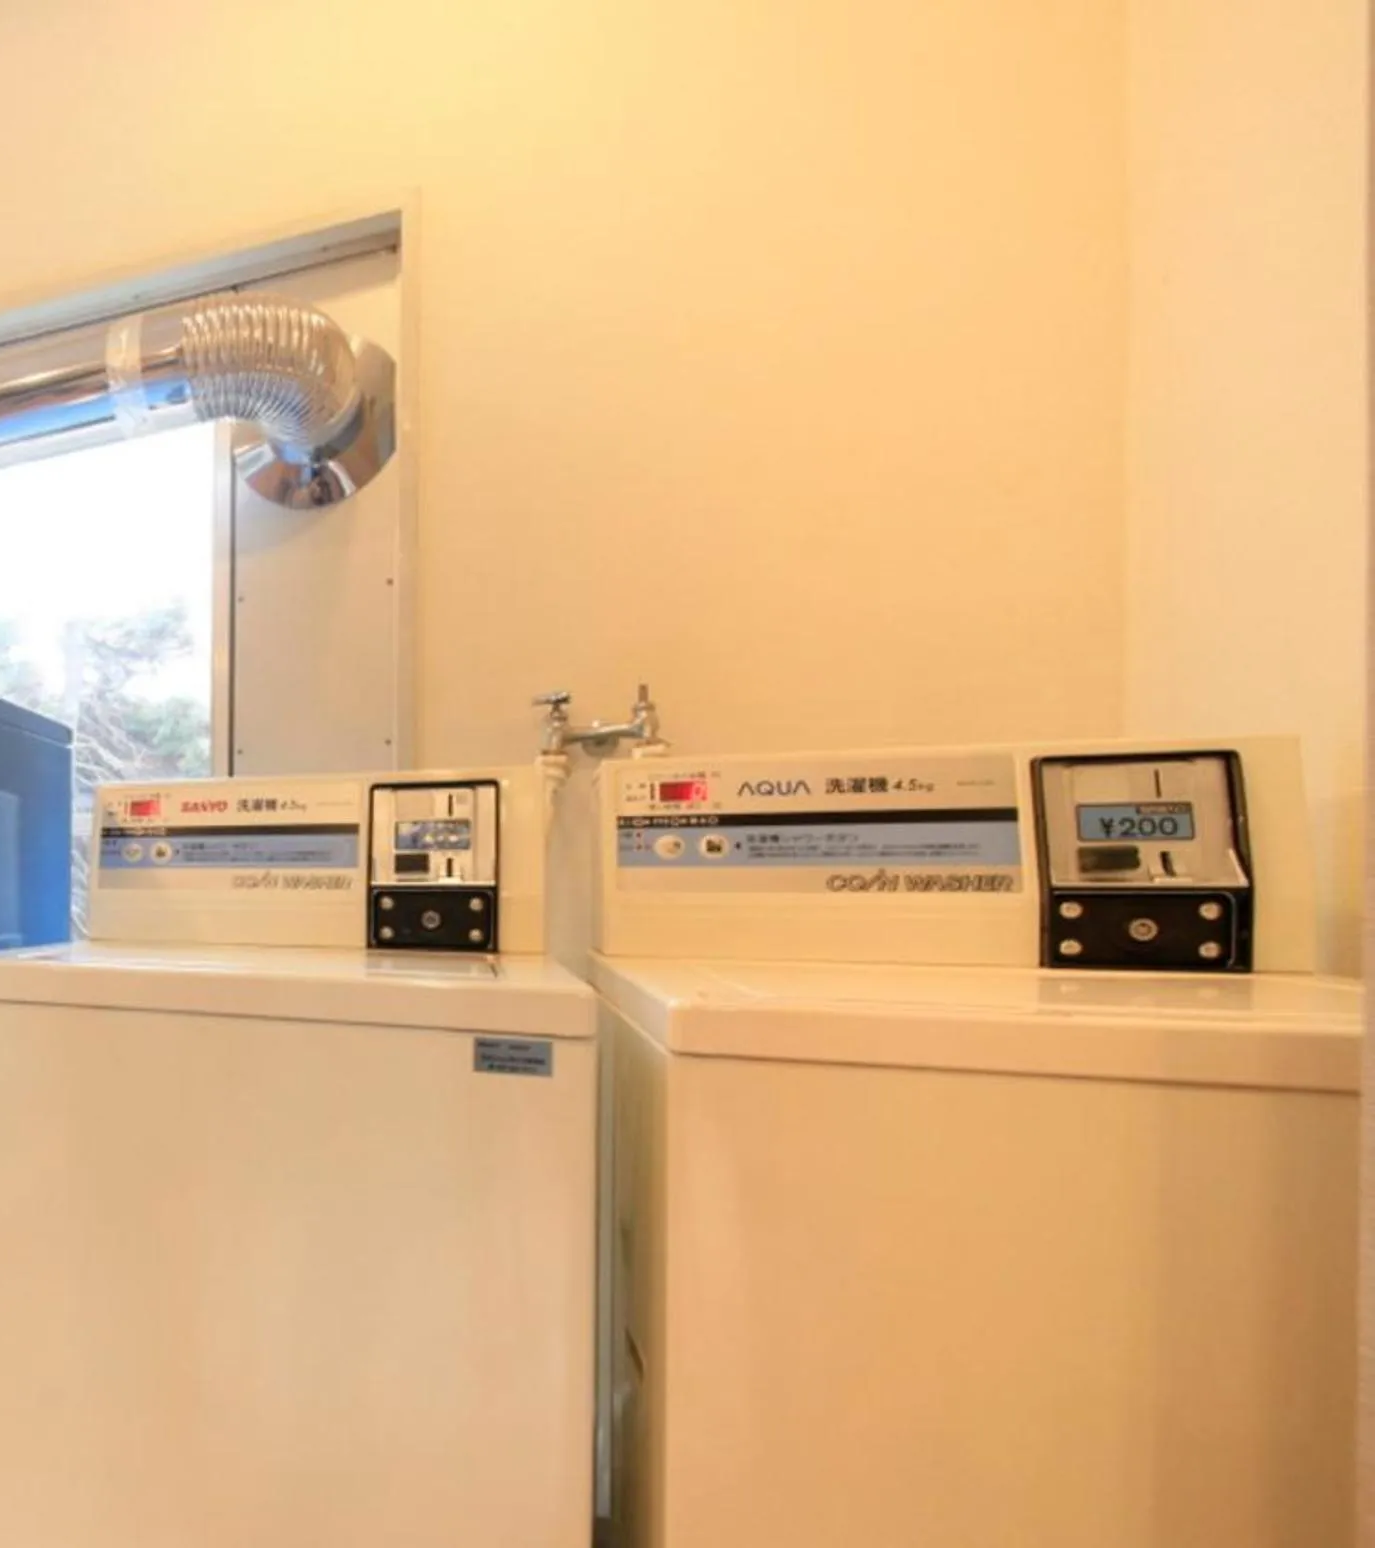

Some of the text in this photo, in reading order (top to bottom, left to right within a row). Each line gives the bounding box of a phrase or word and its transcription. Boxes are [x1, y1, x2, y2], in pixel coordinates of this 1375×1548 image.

[736, 780, 812, 797] AQUA
[825, 777, 888, 793] 洗濯機
[180, 800, 228, 812] SANYO
[1099, 816, 1179, 838] ¥200
[903, 873, 1015, 892] WASHER
